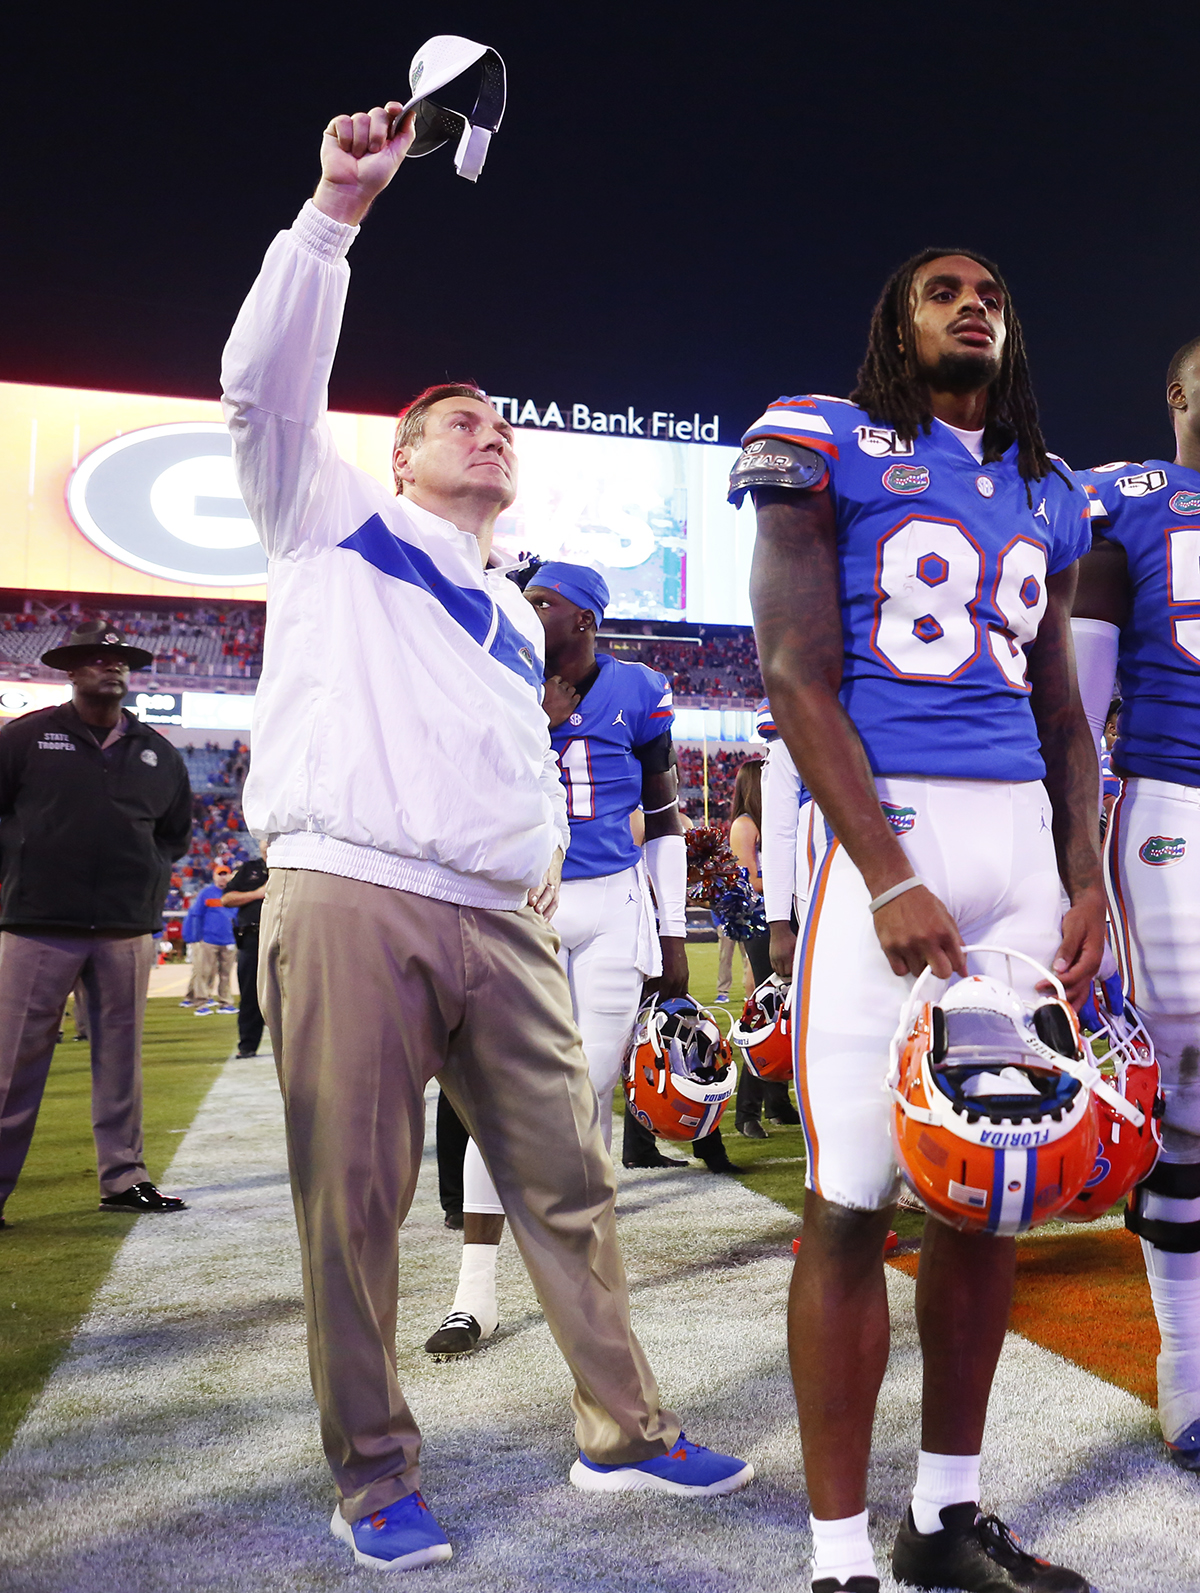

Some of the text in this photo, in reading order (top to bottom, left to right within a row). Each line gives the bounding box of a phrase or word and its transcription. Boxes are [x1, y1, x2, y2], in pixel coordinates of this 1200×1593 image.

[491, 396, 720, 442] TIAA Bank Field
[1114, 469, 1168, 498] 150
[870, 513, 1049, 692] 89
[37, 740, 76, 752] TROOPER
[44, 732, 70, 743] STATE
[557, 736, 596, 820] 1
[703, 1088, 732, 1102] FLORIDA
[980, 1129, 1049, 1144] FLORIDA
